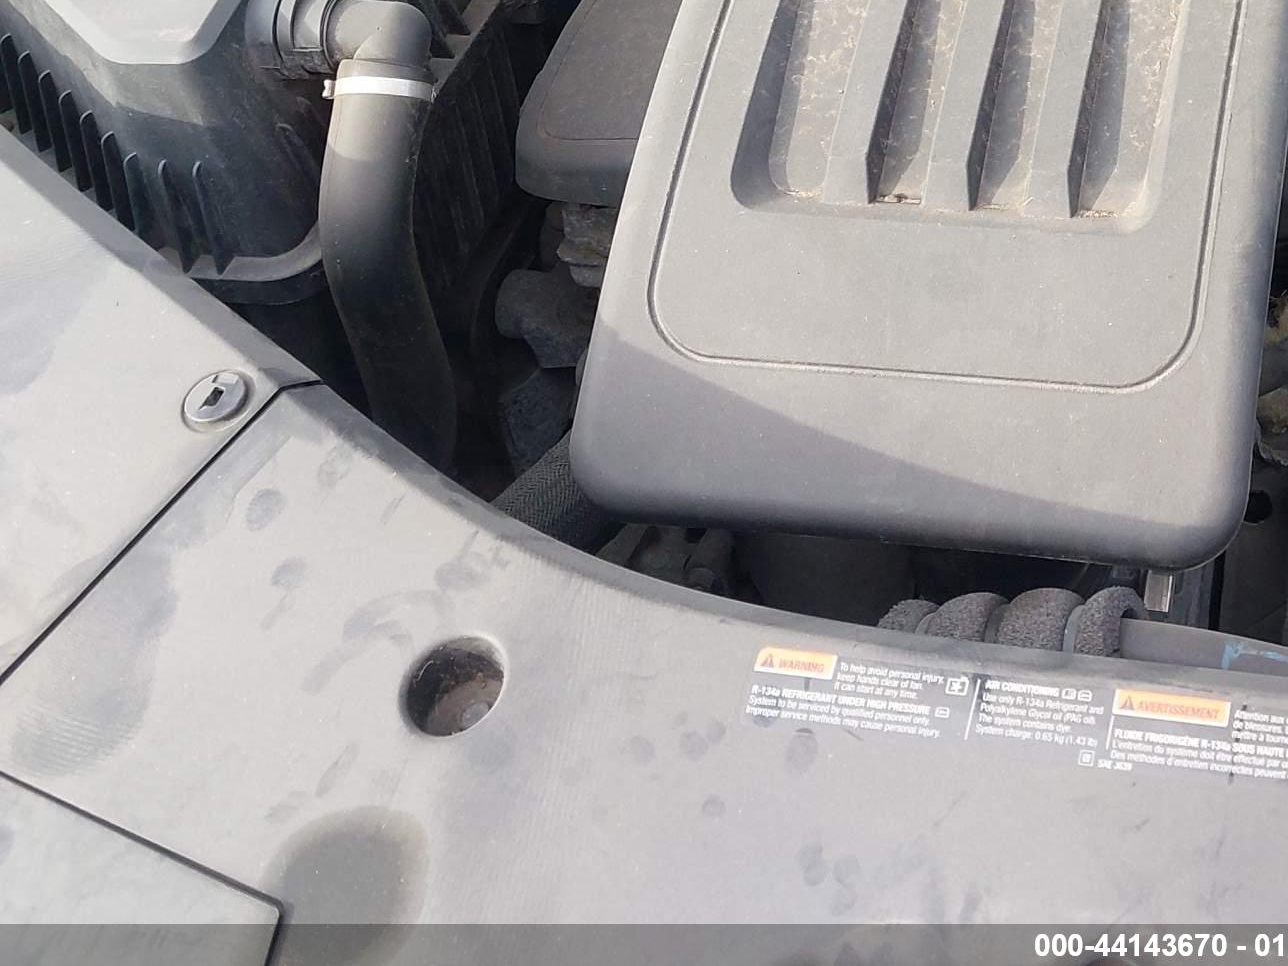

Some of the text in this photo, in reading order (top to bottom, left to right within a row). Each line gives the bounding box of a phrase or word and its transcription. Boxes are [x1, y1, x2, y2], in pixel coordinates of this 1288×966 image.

[779, 659, 824, 673] WARNING
[840, 663, 849, 672] To
[850, 665, 866, 675] help
[867, 667, 889, 677] avoid
[888, 670, 922, 681] personal
[837, 673, 856, 683] keep
[856, 675, 880, 685] hands
[880, 678, 900, 687] clear
[900, 680, 910, 688] of
[985, 680, 1060, 697] AIR CONDITIONING
[840, 684, 856, 692] can
[856, 686, 874, 694] start
[874, 687, 884, 695] at
[884, 689, 899, 698] any
[751, 685, 932, 716] R-134a REFRIGERANT UNDER HIGH PRESSURE
[982, 692, 1104, 715] Use only R-134a Refrigerant and
[750, 695, 777, 707] System
[778, 699, 786, 707] to
[787, 700, 797, 709] be
[798, 702, 830, 713] serviced
[831, 706, 840, 715] by
[874, 713, 912, 724] personnel
[1136, 702, 1220, 719] AVERTISSEMENT
[1234, 710, 1269, 723] Attention
[1270, 715, 1285, 724] aux
[745, 705, 780, 718] Improper
[780, 712, 808, 721] service
[808, 714, 842, 725] methods
[842, 719, 858, 729] may
[860, 721, 884, 731] cause
[884, 724, 918, 735] personal
[978, 713, 993, 723] The
[994, 717, 1022, 727] system
[1022, 721, 1055, 731] contains
[1232, 721, 1244, 729] de
[976, 724, 1004, 736] System
[1232, 731, 1258, 741] mettre
[1114, 729, 1144, 741] FLUIDE
[1200, 739, 1232, 752] R-134a
[1232, 743, 1256, 754] SOUS
[1256, 746, 1284, 758] HAUTE
[1098, 759, 1112, 769] SAE
[1110, 750, 1126, 760] Des
[1254, 769, 1286, 780] peuvent
[1154, 745, 1164, 754] du
[1200, 750, 1215, 760] doit
[1266, 760, 1280, 768] par
